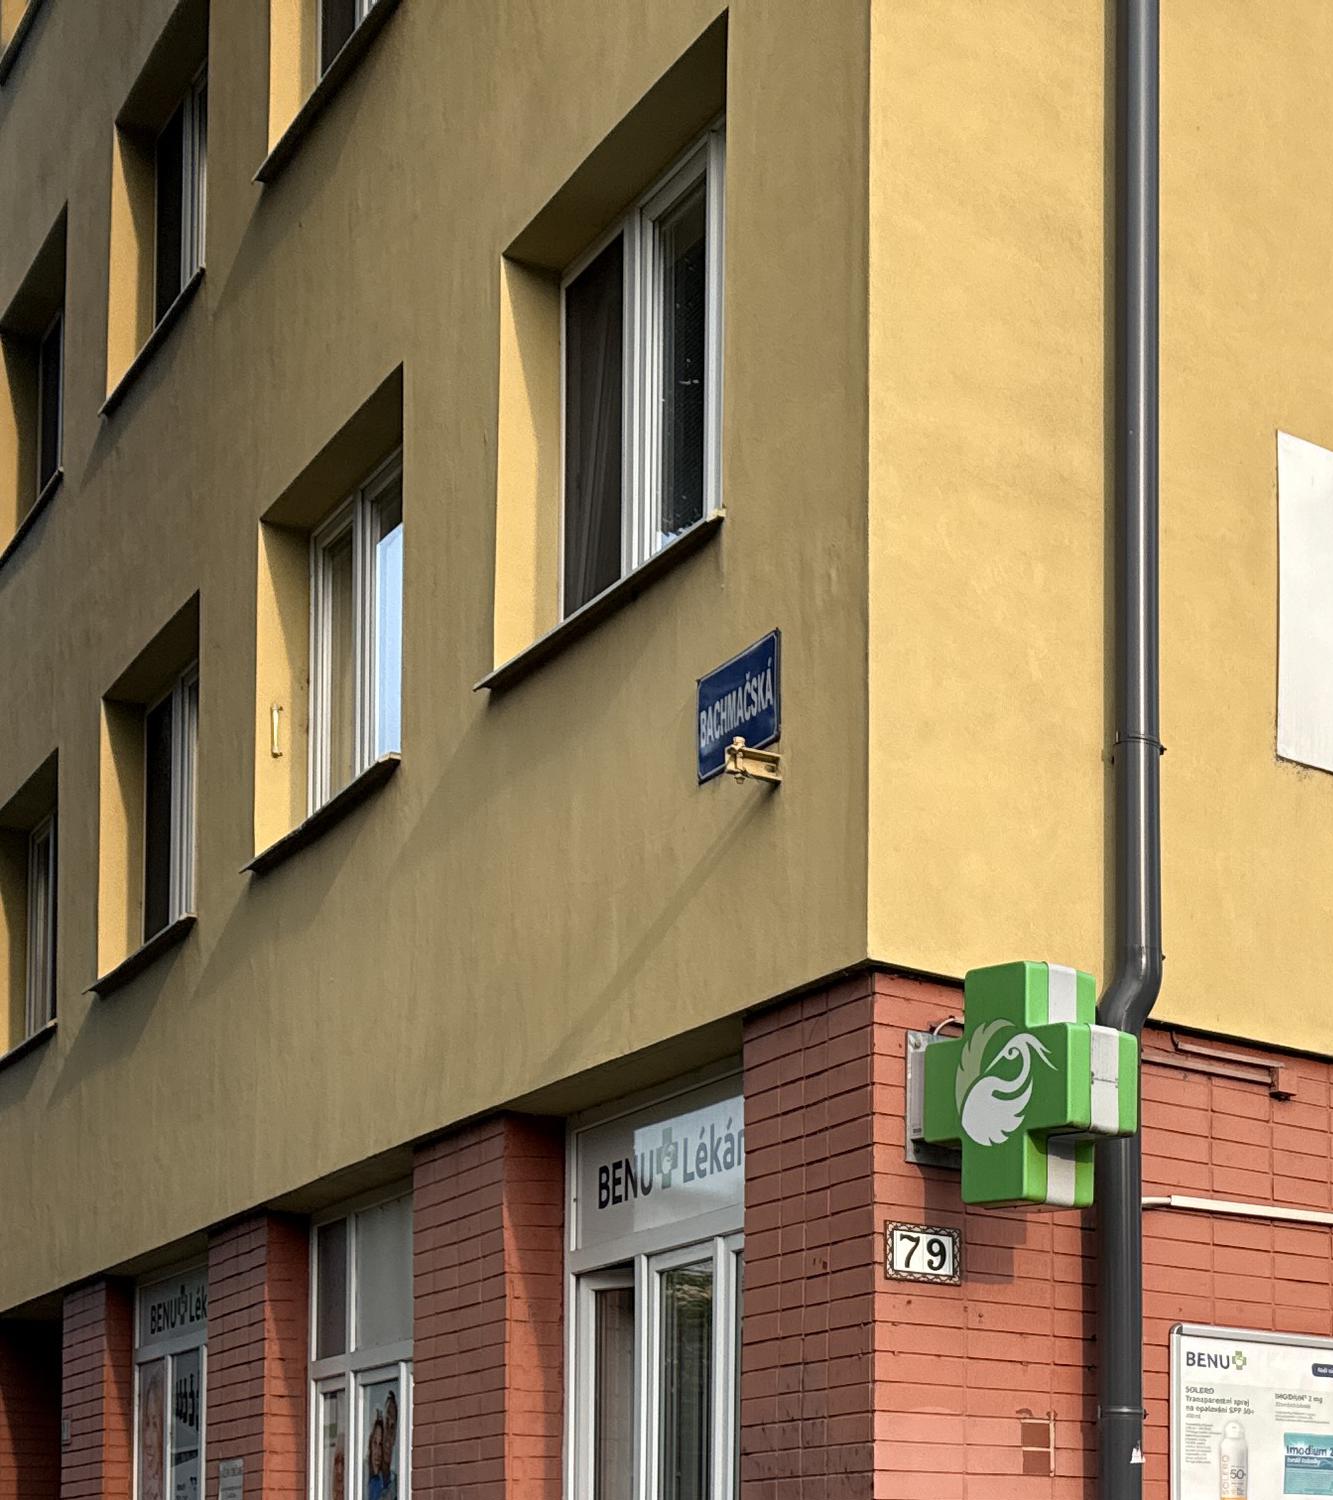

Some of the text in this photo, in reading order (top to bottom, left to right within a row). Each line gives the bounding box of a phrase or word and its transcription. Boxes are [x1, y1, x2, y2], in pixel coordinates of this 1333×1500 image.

[700, 657, 773, 747] BACHMAČSKÁ
[598, 1117, 744, 1210] BENU Lékár
[900, 1235, 947, 1271] 79
[150, 1297, 177, 1335] BENU
[1186, 1351, 1230, 1369] BENU
[1286, 1445, 1327, 1456] Imodium
